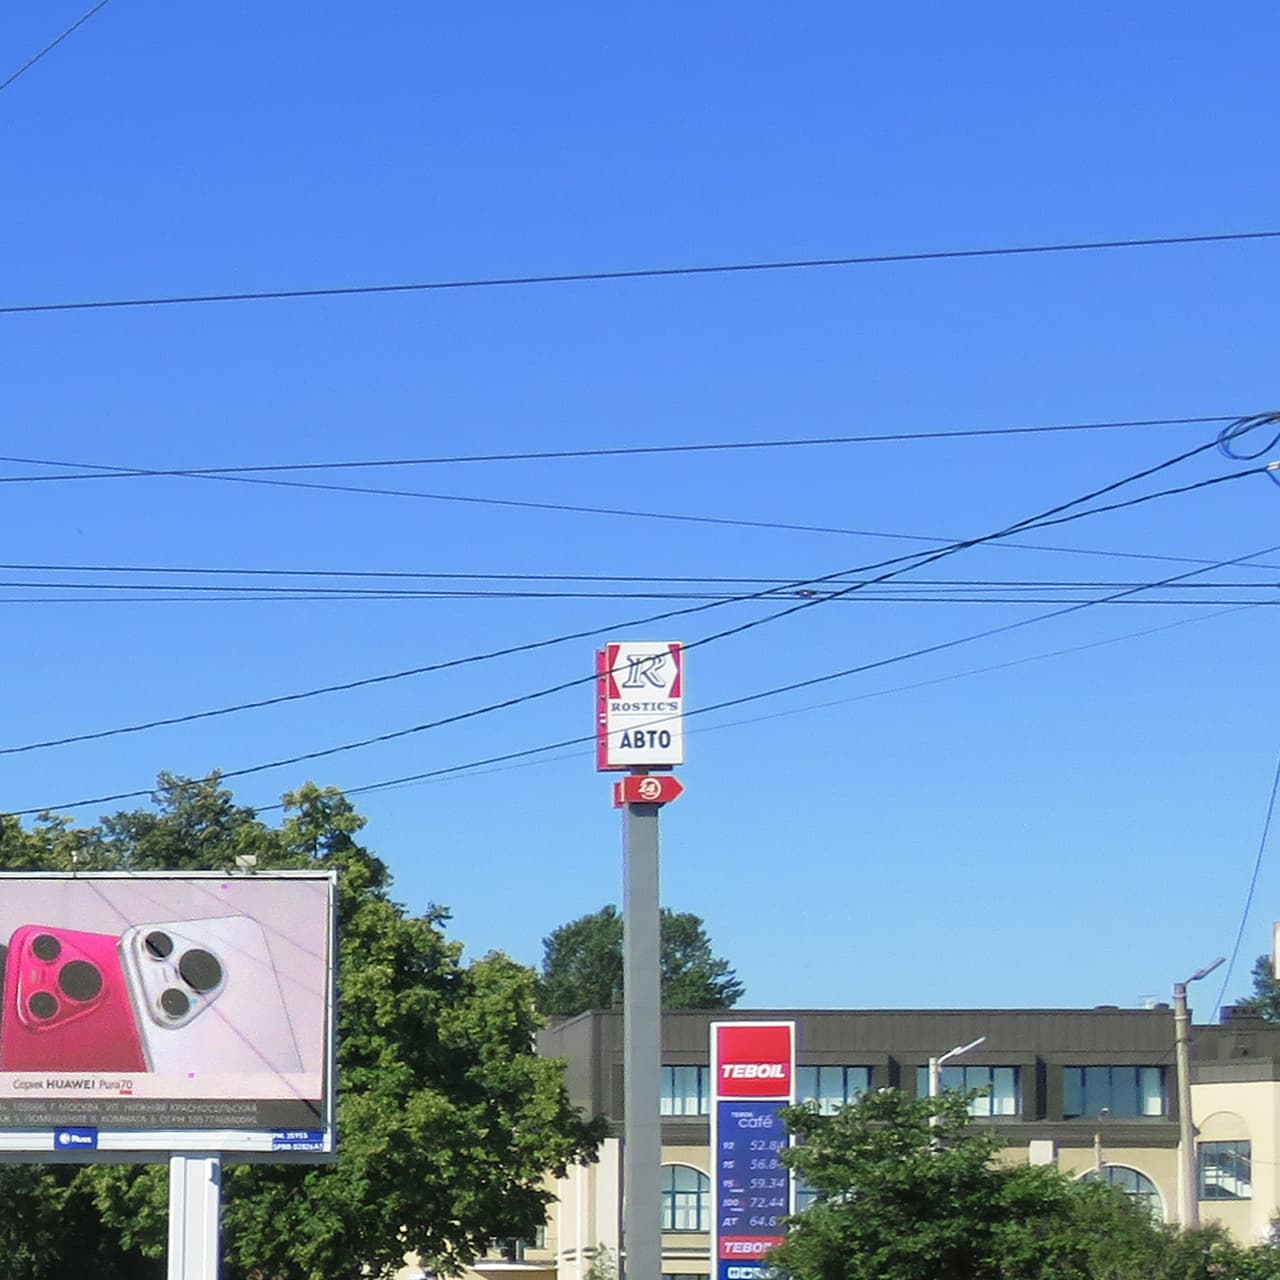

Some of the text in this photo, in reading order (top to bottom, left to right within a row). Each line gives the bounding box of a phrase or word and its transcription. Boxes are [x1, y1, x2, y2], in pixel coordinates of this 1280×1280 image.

[611, 702, 679, 712] ROSTIC'S
[619, 730, 671, 749] АВТО
[721, 1063, 785, 1078] TEBOIL
[46, 1079, 95, 1089] HUAWEI
[738, 1115, 772, 1128] café
[722, 1142, 735, 1150] 92
[722, 1161, 735, 1169] 95
[749, 1178, 784, 1189] 59.34
[749, 1197, 785, 1208] 72.44
